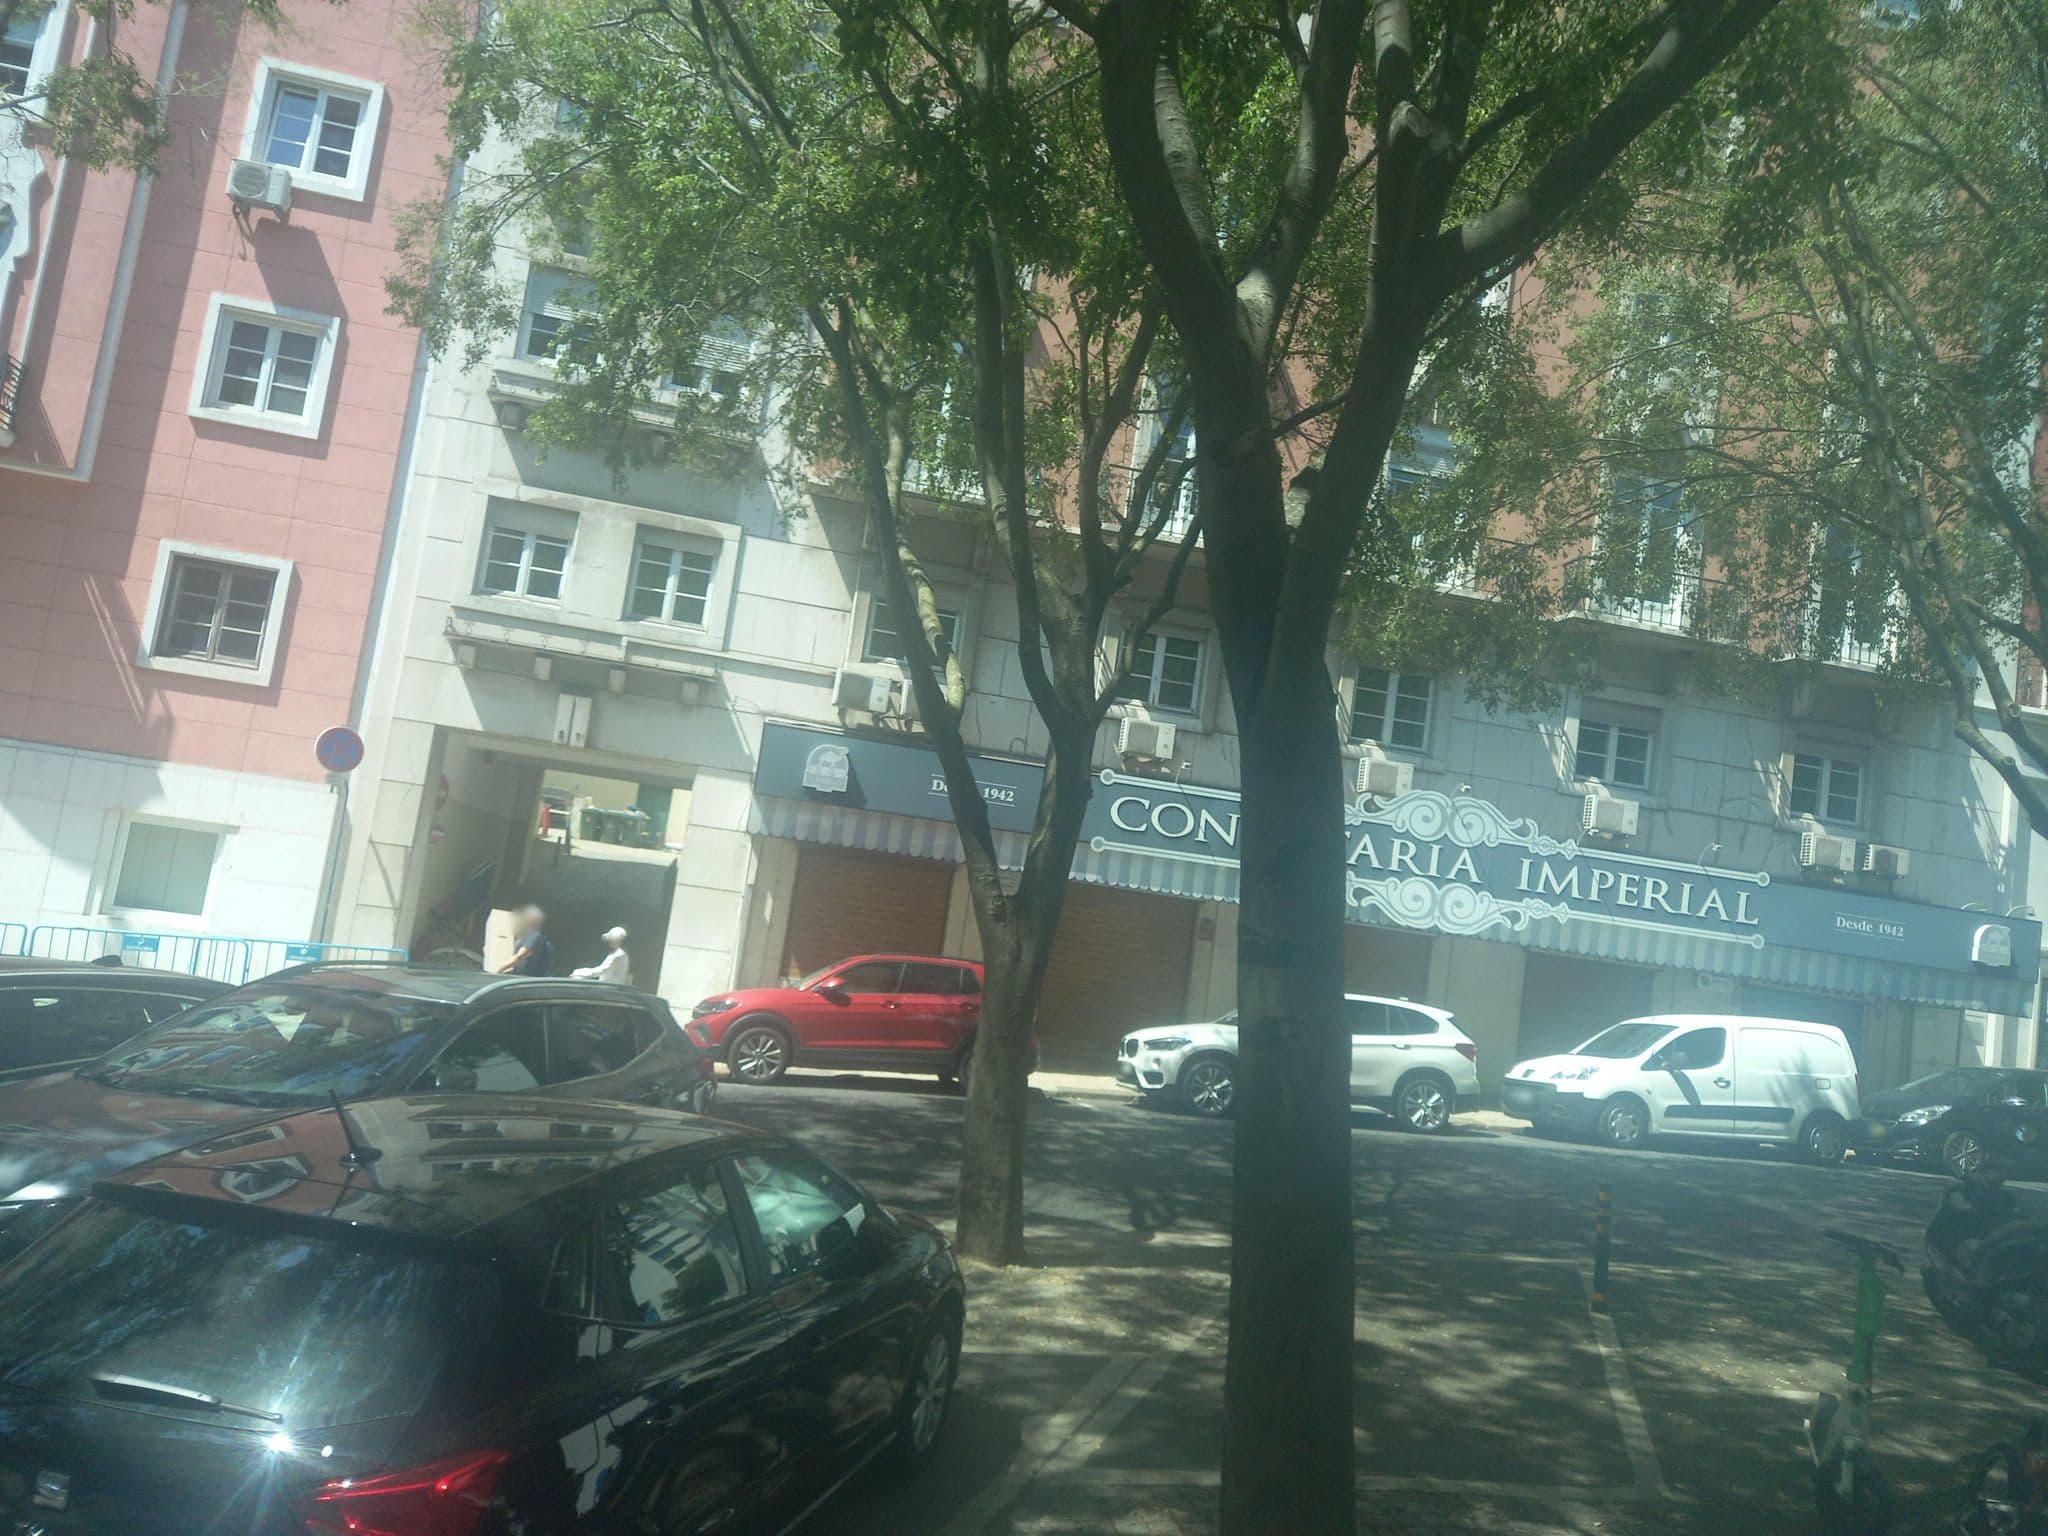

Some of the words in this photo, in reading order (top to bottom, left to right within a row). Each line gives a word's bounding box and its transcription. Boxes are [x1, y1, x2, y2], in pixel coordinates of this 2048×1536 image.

[982, 787, 1014, 802] 1942
[1109, 795, 1483, 884] CONARIA
[1515, 857, 1760, 926] IMPERIAL
[1836, 916, 1873, 933] Desde
[1879, 923, 1904, 937] 1942
